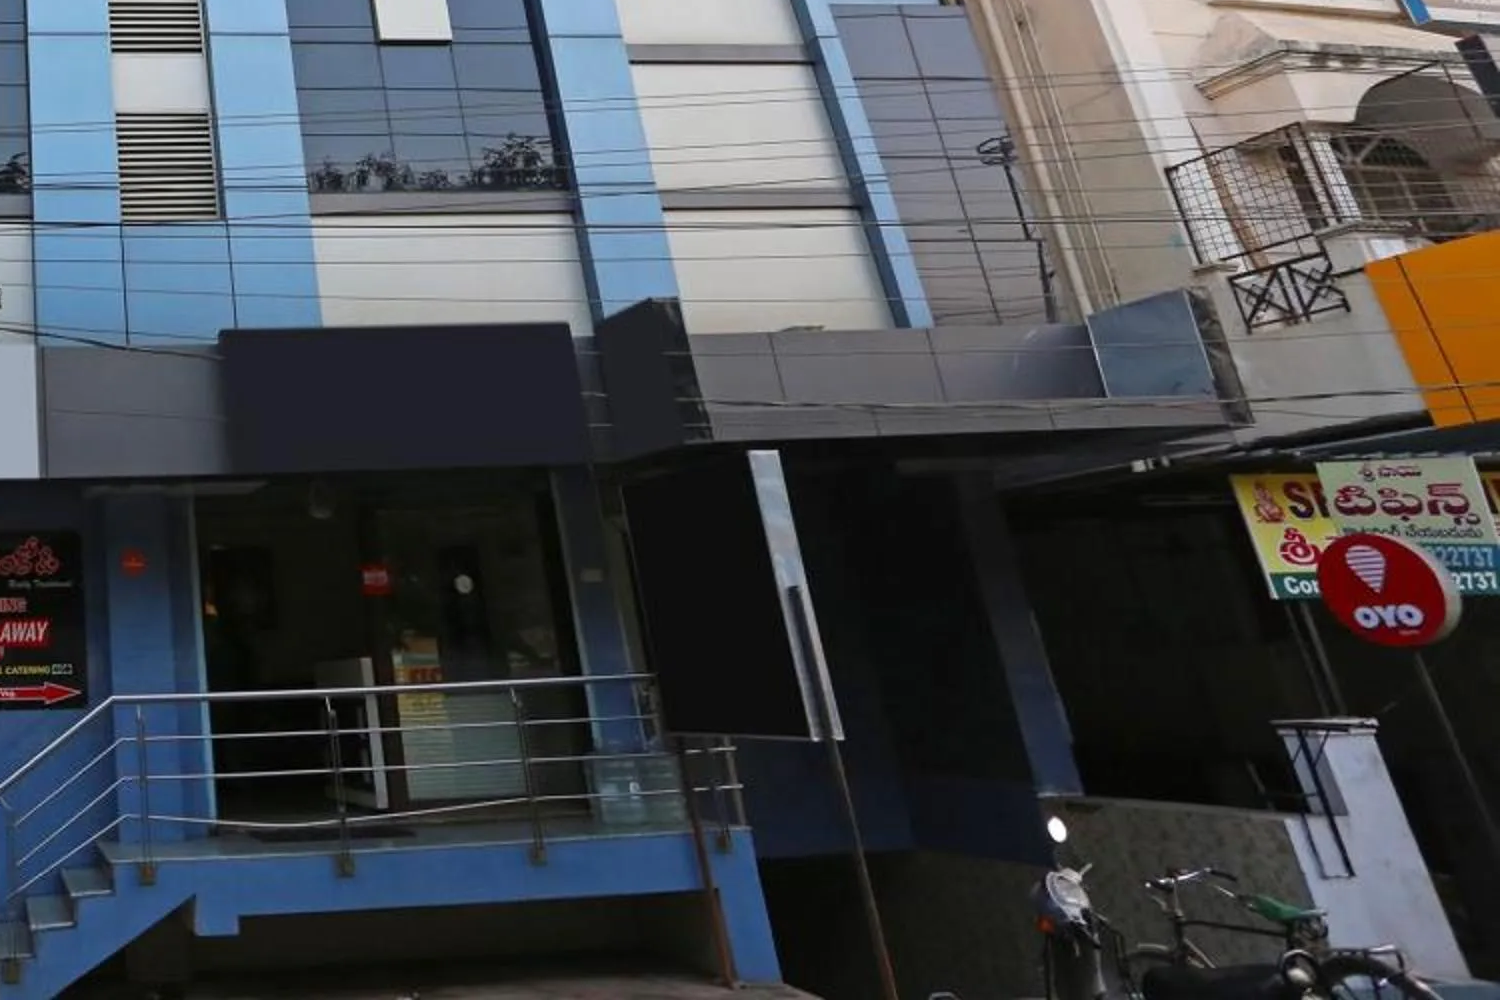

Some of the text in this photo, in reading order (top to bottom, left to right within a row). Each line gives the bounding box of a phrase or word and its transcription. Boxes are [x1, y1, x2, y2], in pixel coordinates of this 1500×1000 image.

[1353, 603, 1424, 629] OYO
[0, 621, 48, 642] AWAY
[5, 665, 50, 675] CATERING
